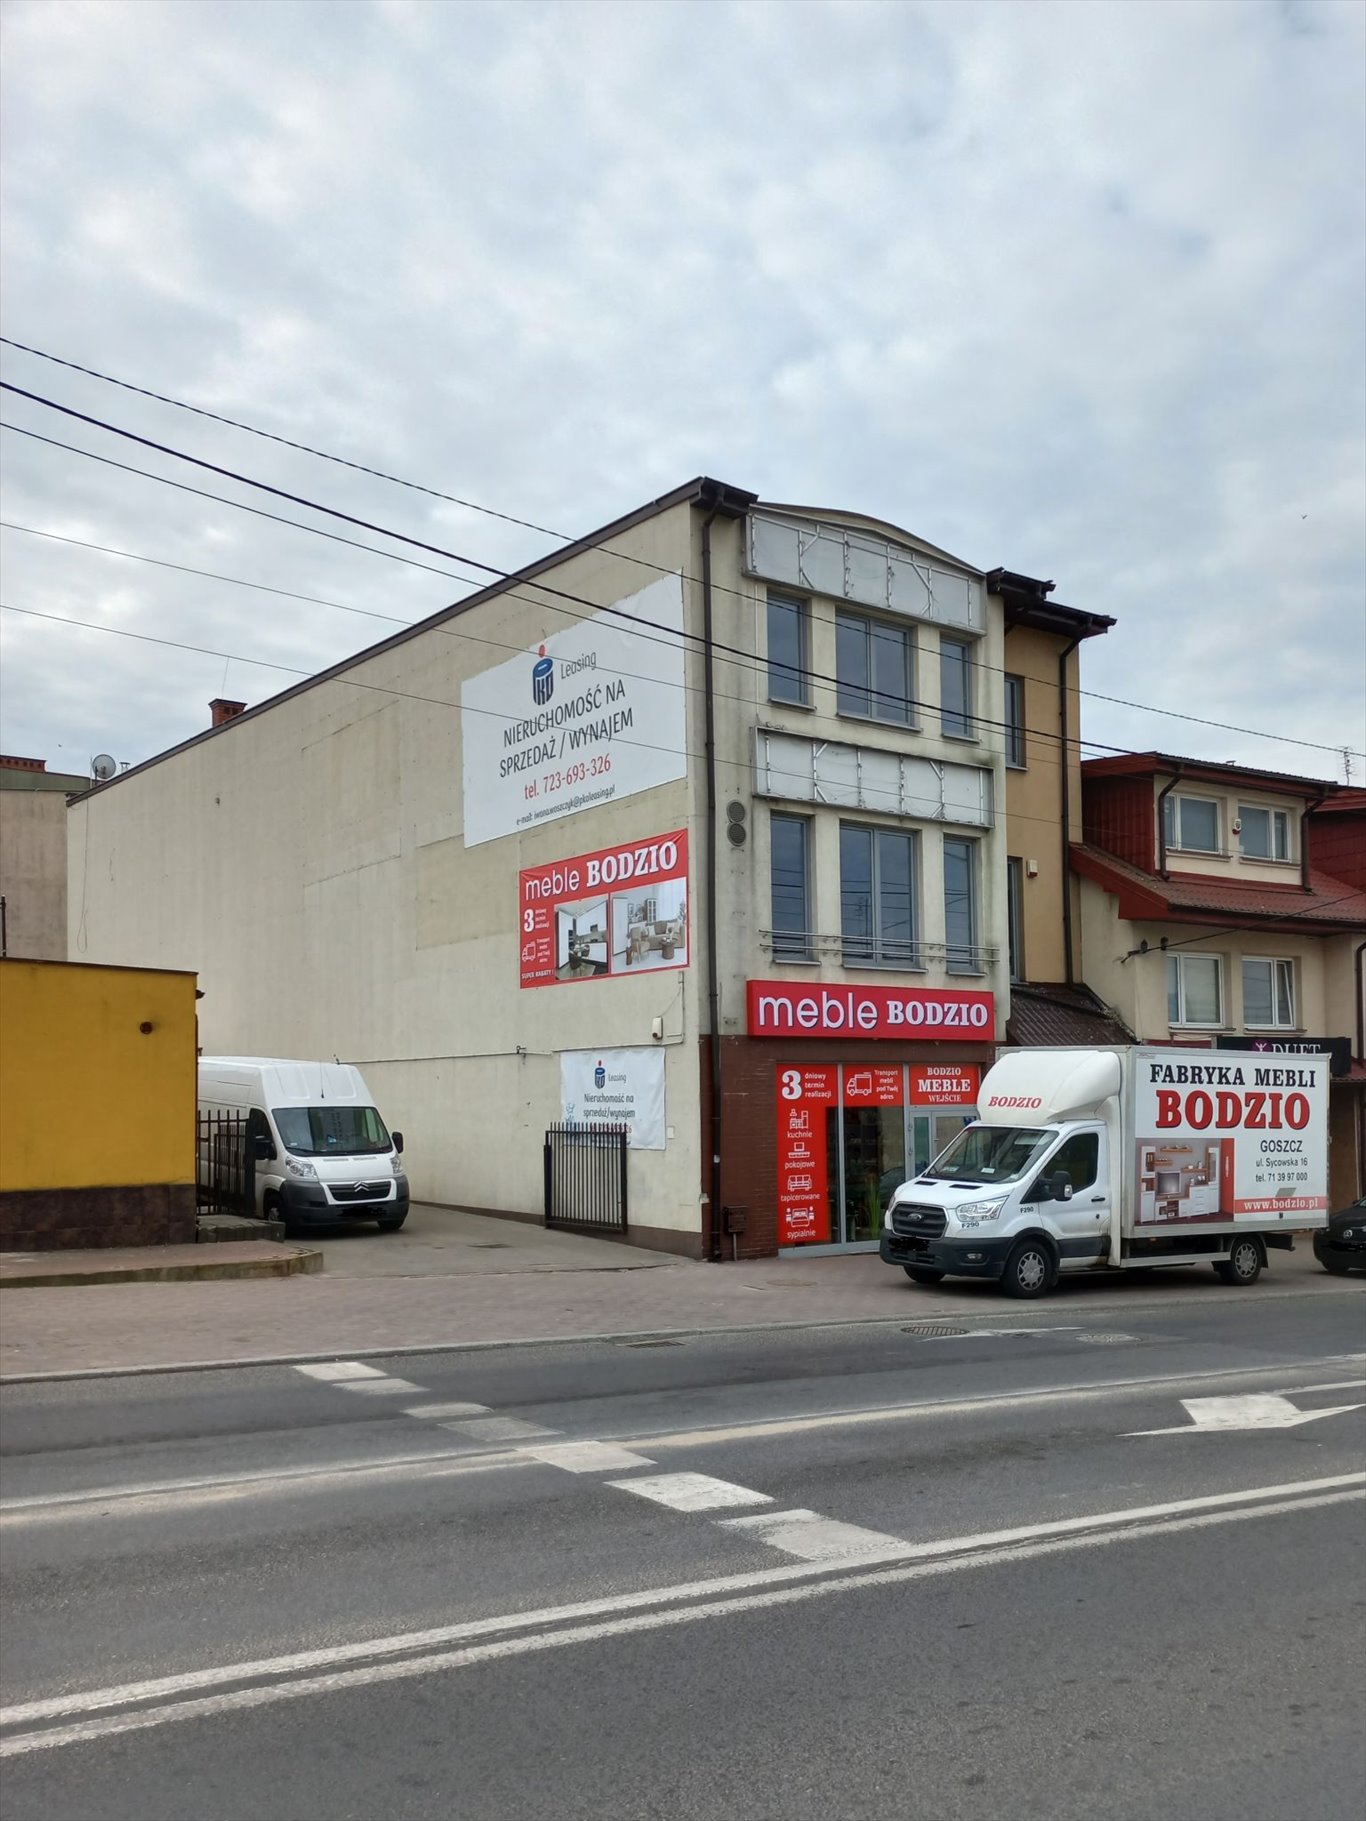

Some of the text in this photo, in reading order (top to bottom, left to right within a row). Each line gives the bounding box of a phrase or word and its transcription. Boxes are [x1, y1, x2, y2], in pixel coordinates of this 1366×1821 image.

[560, 651, 596, 679] Leasing
[503, 679, 626, 747] NIERUCHOMOŚĆ NA
[499, 734, 556, 778] SPRZEDAŻ
[569, 707, 633, 751] WYNAJEM
[524, 753, 611, 799] tel. 723-693-326
[525, 841, 677, 901] meble BODZIO
[523, 908, 535, 932] 3
[758, 991, 988, 1030] meble BODZIO
[804, 1072, 826, 1081] dniowy
[927, 1067, 961, 1076] BODZIO
[1150, 1063, 1316, 1088] FABRYKA MEBLI
[608, 1073, 627, 1083] Leasing
[781, 1070, 803, 1100] 3
[886, 1085, 899, 1093] Twój
[918, 1079, 971, 1092] MEBLE
[584, 1093, 625, 1103] Nieruchomość
[804, 1090, 832, 1099] realizacji
[928, 1093, 962, 1103] WEJŚCIE
[988, 1096, 1042, 1109] BODZIO
[1155, 1089, 1311, 1131] BODZIO
[787, 1130, 813, 1139] kuchnie
[1260, 1140, 1303, 1153] GOSZCZ
[785, 1160, 815, 1170] pokojowe
[1255, 1157, 1308, 1168] ul. Sycowska 16
[1255, 1173, 1308, 1182] tel. 71 39 97 000
[780, 1191, 821, 1202] tapicerowane
[1243, 1197, 1318, 1211] www.bodzio.pl
[961, 1221, 980, 1229] F290
[786, 1228, 816, 1239] sypialnie
